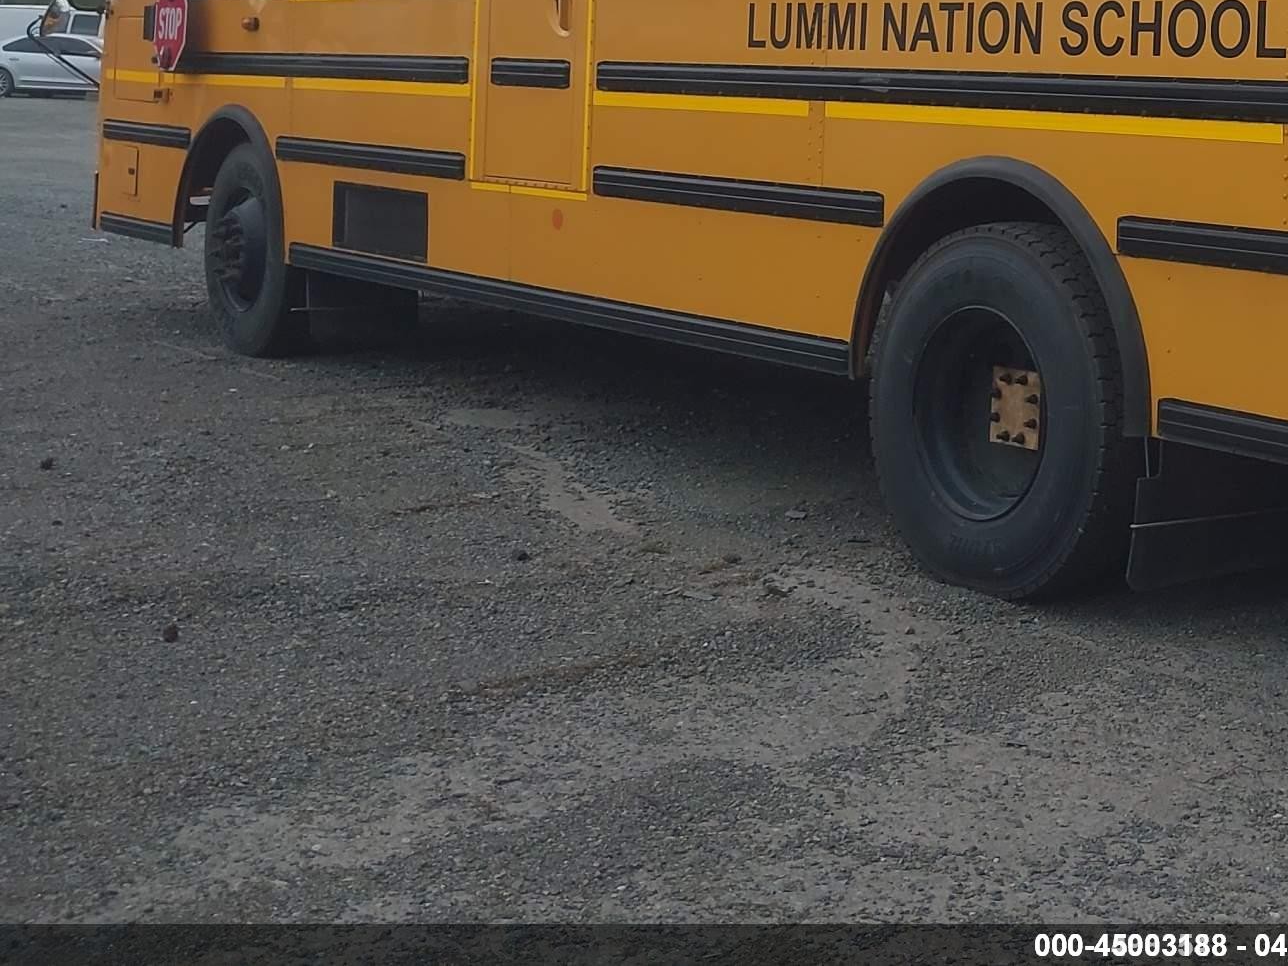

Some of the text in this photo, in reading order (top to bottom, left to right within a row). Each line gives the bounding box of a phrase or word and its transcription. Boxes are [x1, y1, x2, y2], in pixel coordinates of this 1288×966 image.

[158, 7, 182, 40] STOP
[747, 0, 1287, 59] LUMMI NATION SCHOOL
